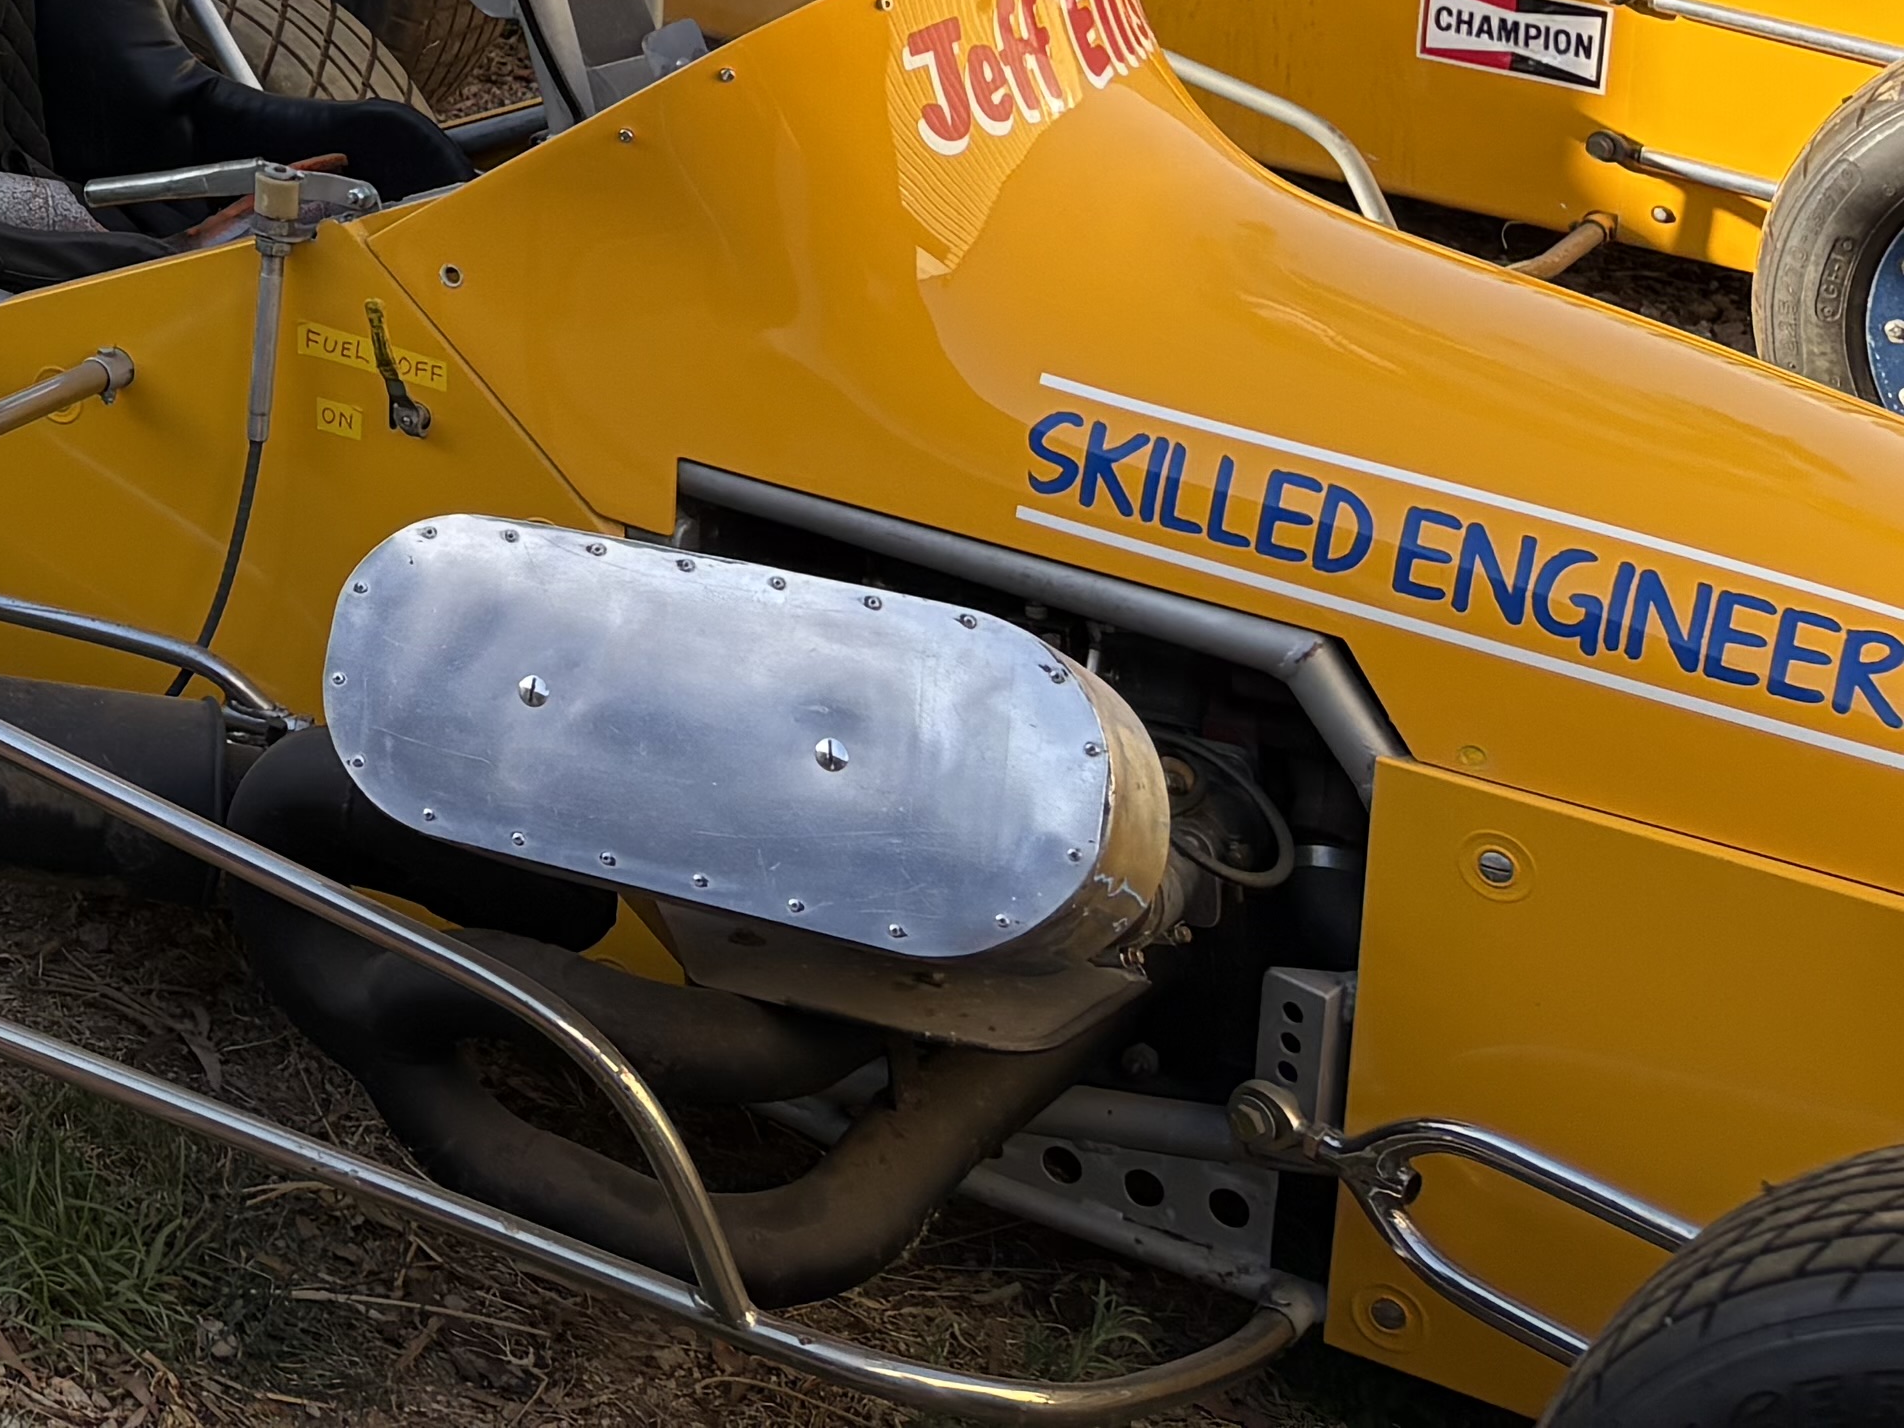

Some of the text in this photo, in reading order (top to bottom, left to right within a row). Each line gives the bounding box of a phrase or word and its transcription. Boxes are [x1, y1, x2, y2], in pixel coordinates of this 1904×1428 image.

[1432, 4, 1596, 62] CHAMPION
[305, 328, 444, 382] FUEL OFF
[321, 406, 353, 430] ON
[1027, 411, 1904, 728] SKILLED ENGINEER
